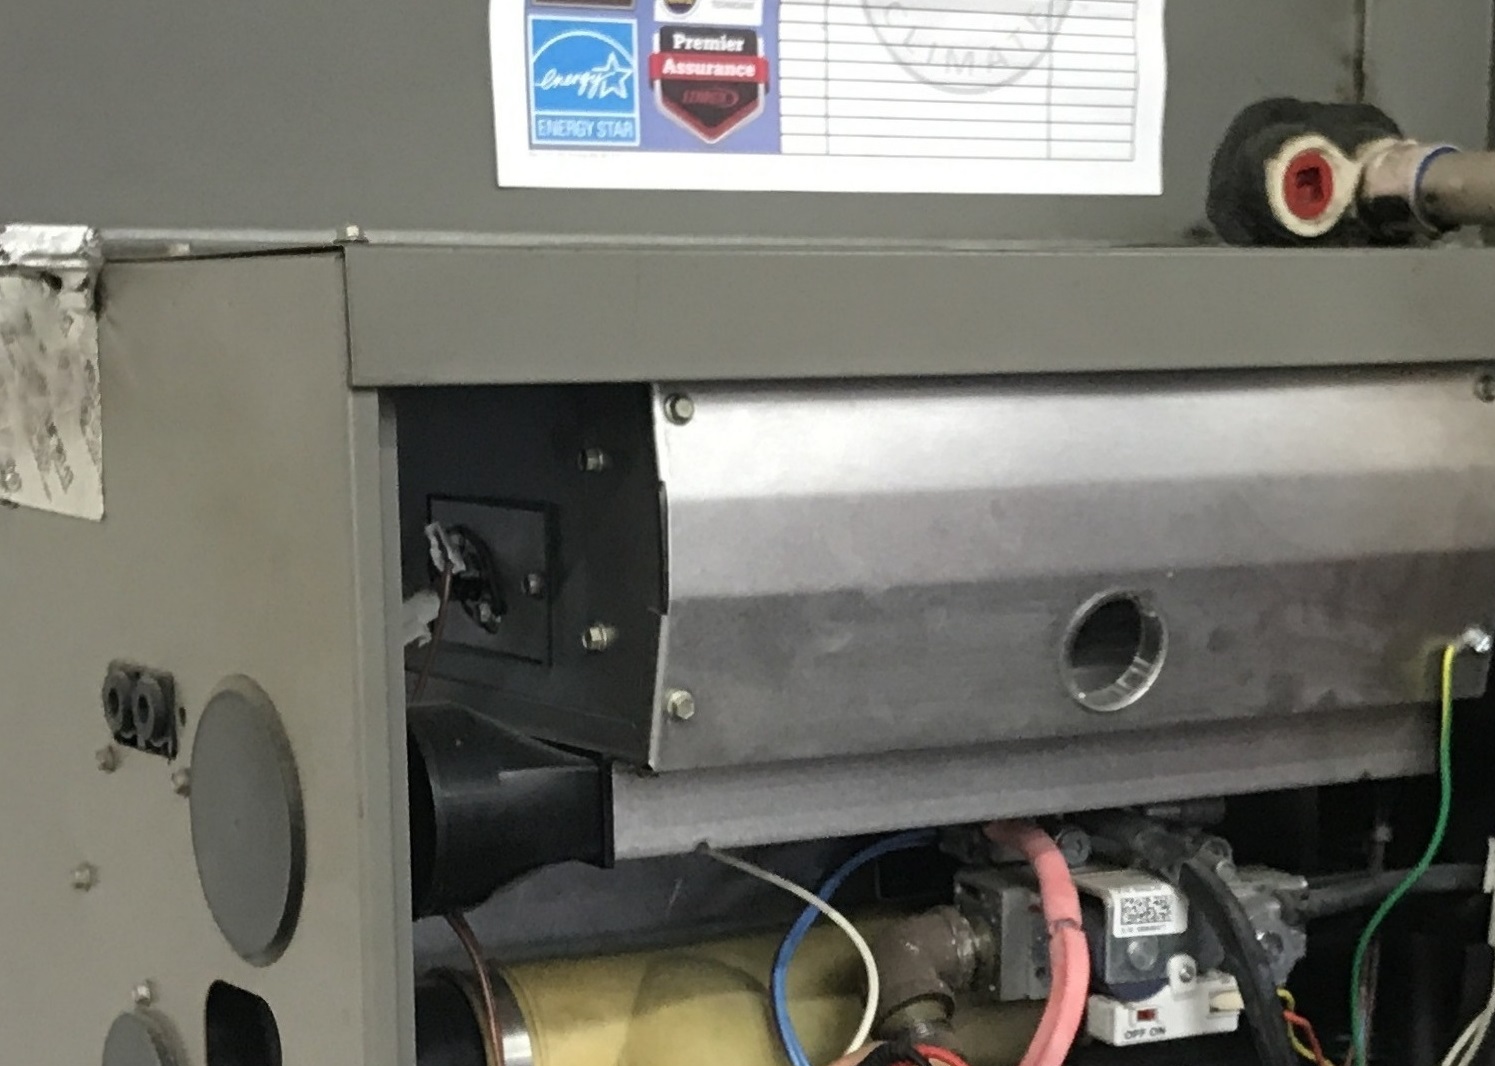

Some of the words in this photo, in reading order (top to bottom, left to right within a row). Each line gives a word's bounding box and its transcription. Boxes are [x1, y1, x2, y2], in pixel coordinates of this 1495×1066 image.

[672, 32, 745, 52] Premier
[662, 58, 756, 77] Assurance
[535, 68, 603, 99] energy
[537, 119, 595, 138] ENERGY
[596, 120, 634, 138] STAR
[1123, 1027, 1146, 1040] OFF
[1149, 1026, 1167, 1037] ON
